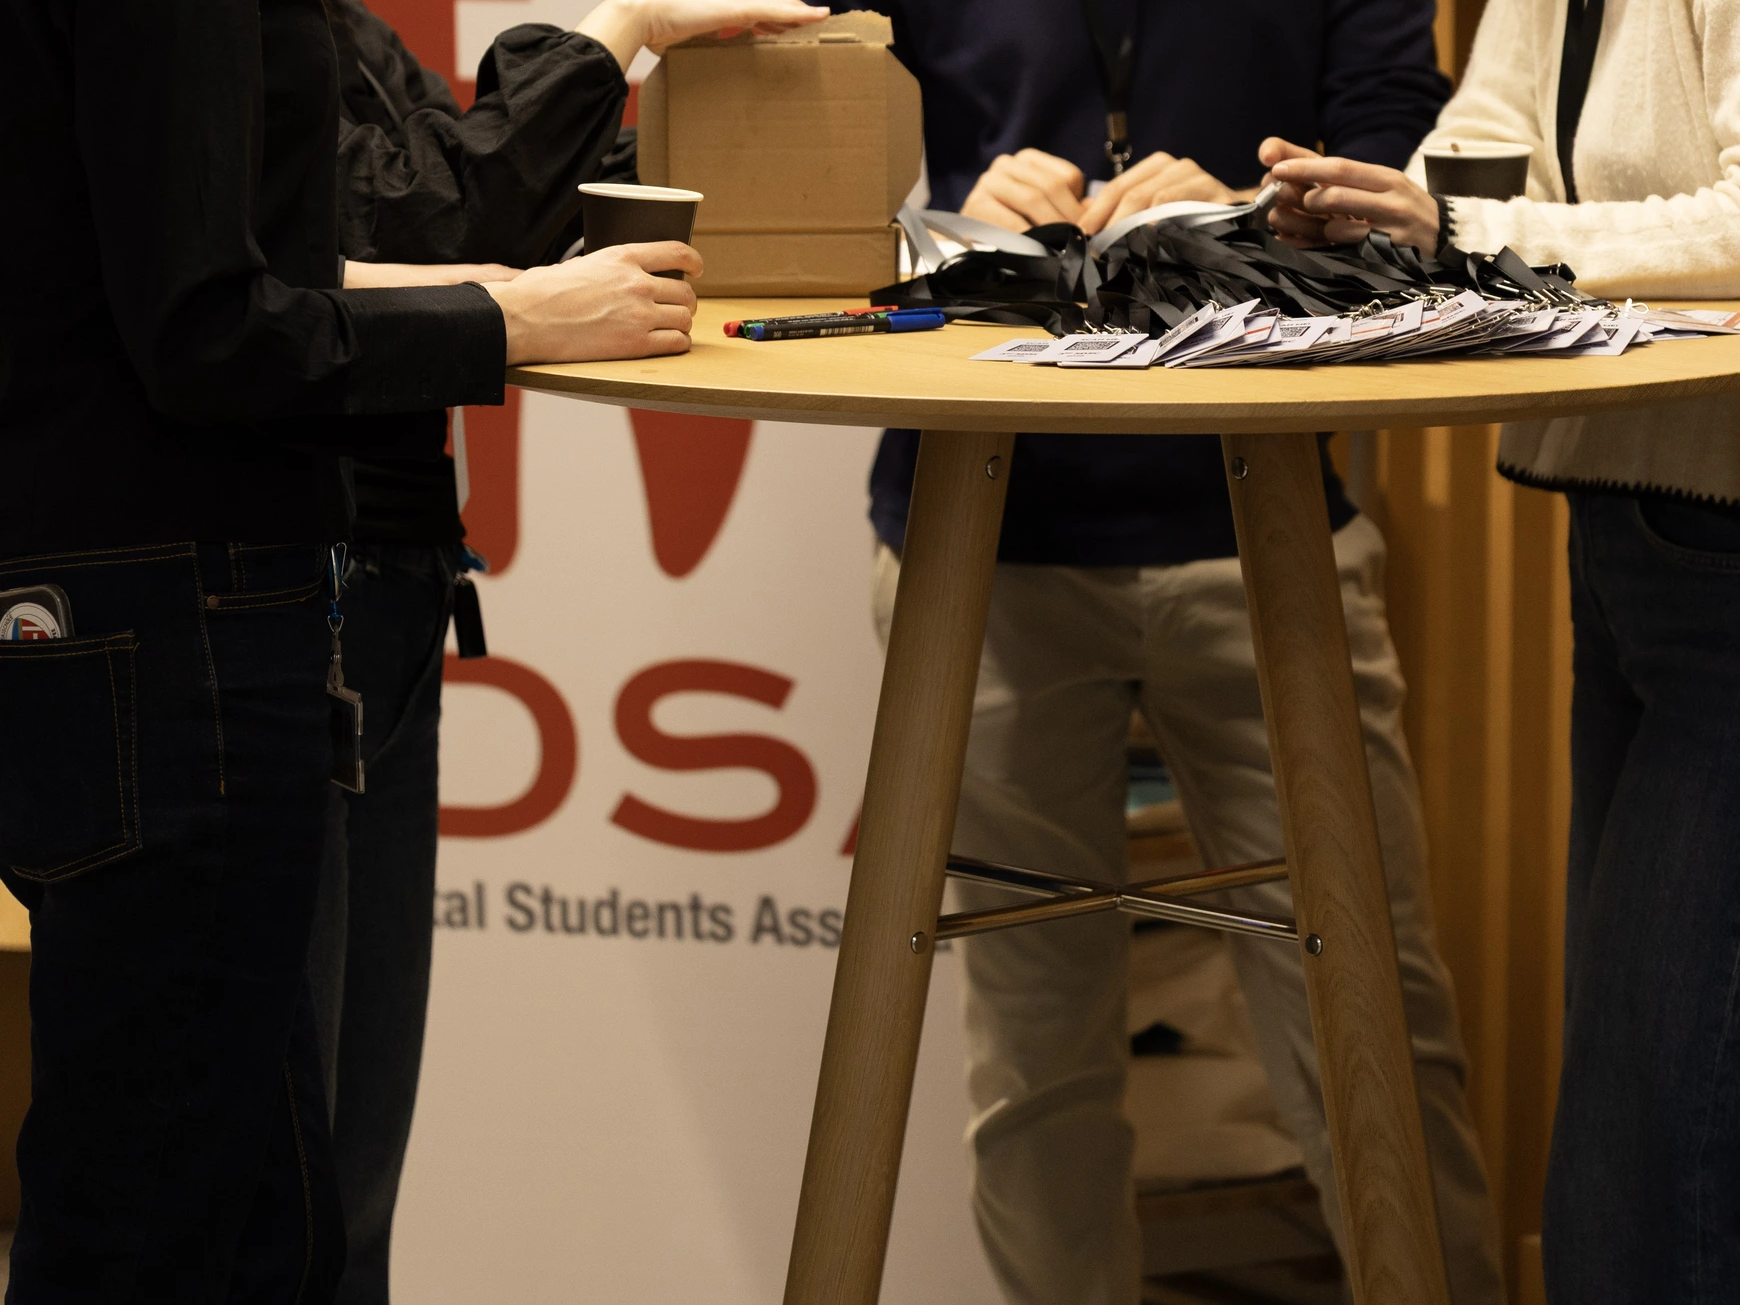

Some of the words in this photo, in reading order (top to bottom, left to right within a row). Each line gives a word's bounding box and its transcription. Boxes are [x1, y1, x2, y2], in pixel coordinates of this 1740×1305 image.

[437, 652, 861, 856] DS
[433, 881, 485, 930] al
[505, 882, 734, 942] Students
[751, 895, 844, 949] Ass
